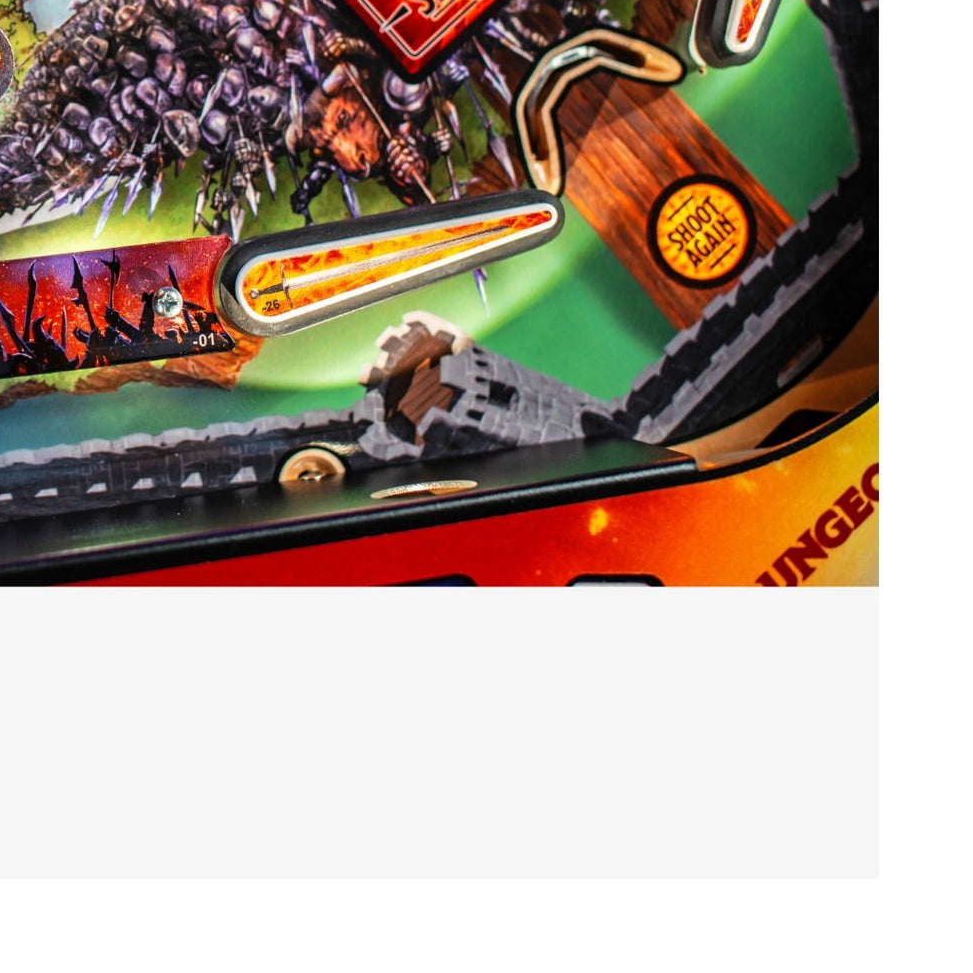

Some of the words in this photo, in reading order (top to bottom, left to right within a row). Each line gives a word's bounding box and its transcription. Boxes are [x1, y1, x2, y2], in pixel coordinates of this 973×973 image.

[668, 196, 720, 251] SHOOT
[686, 214, 737, 268] AGAIN
[262, 299, 281, 312] -26
[192, 332, 215, 347] -01
